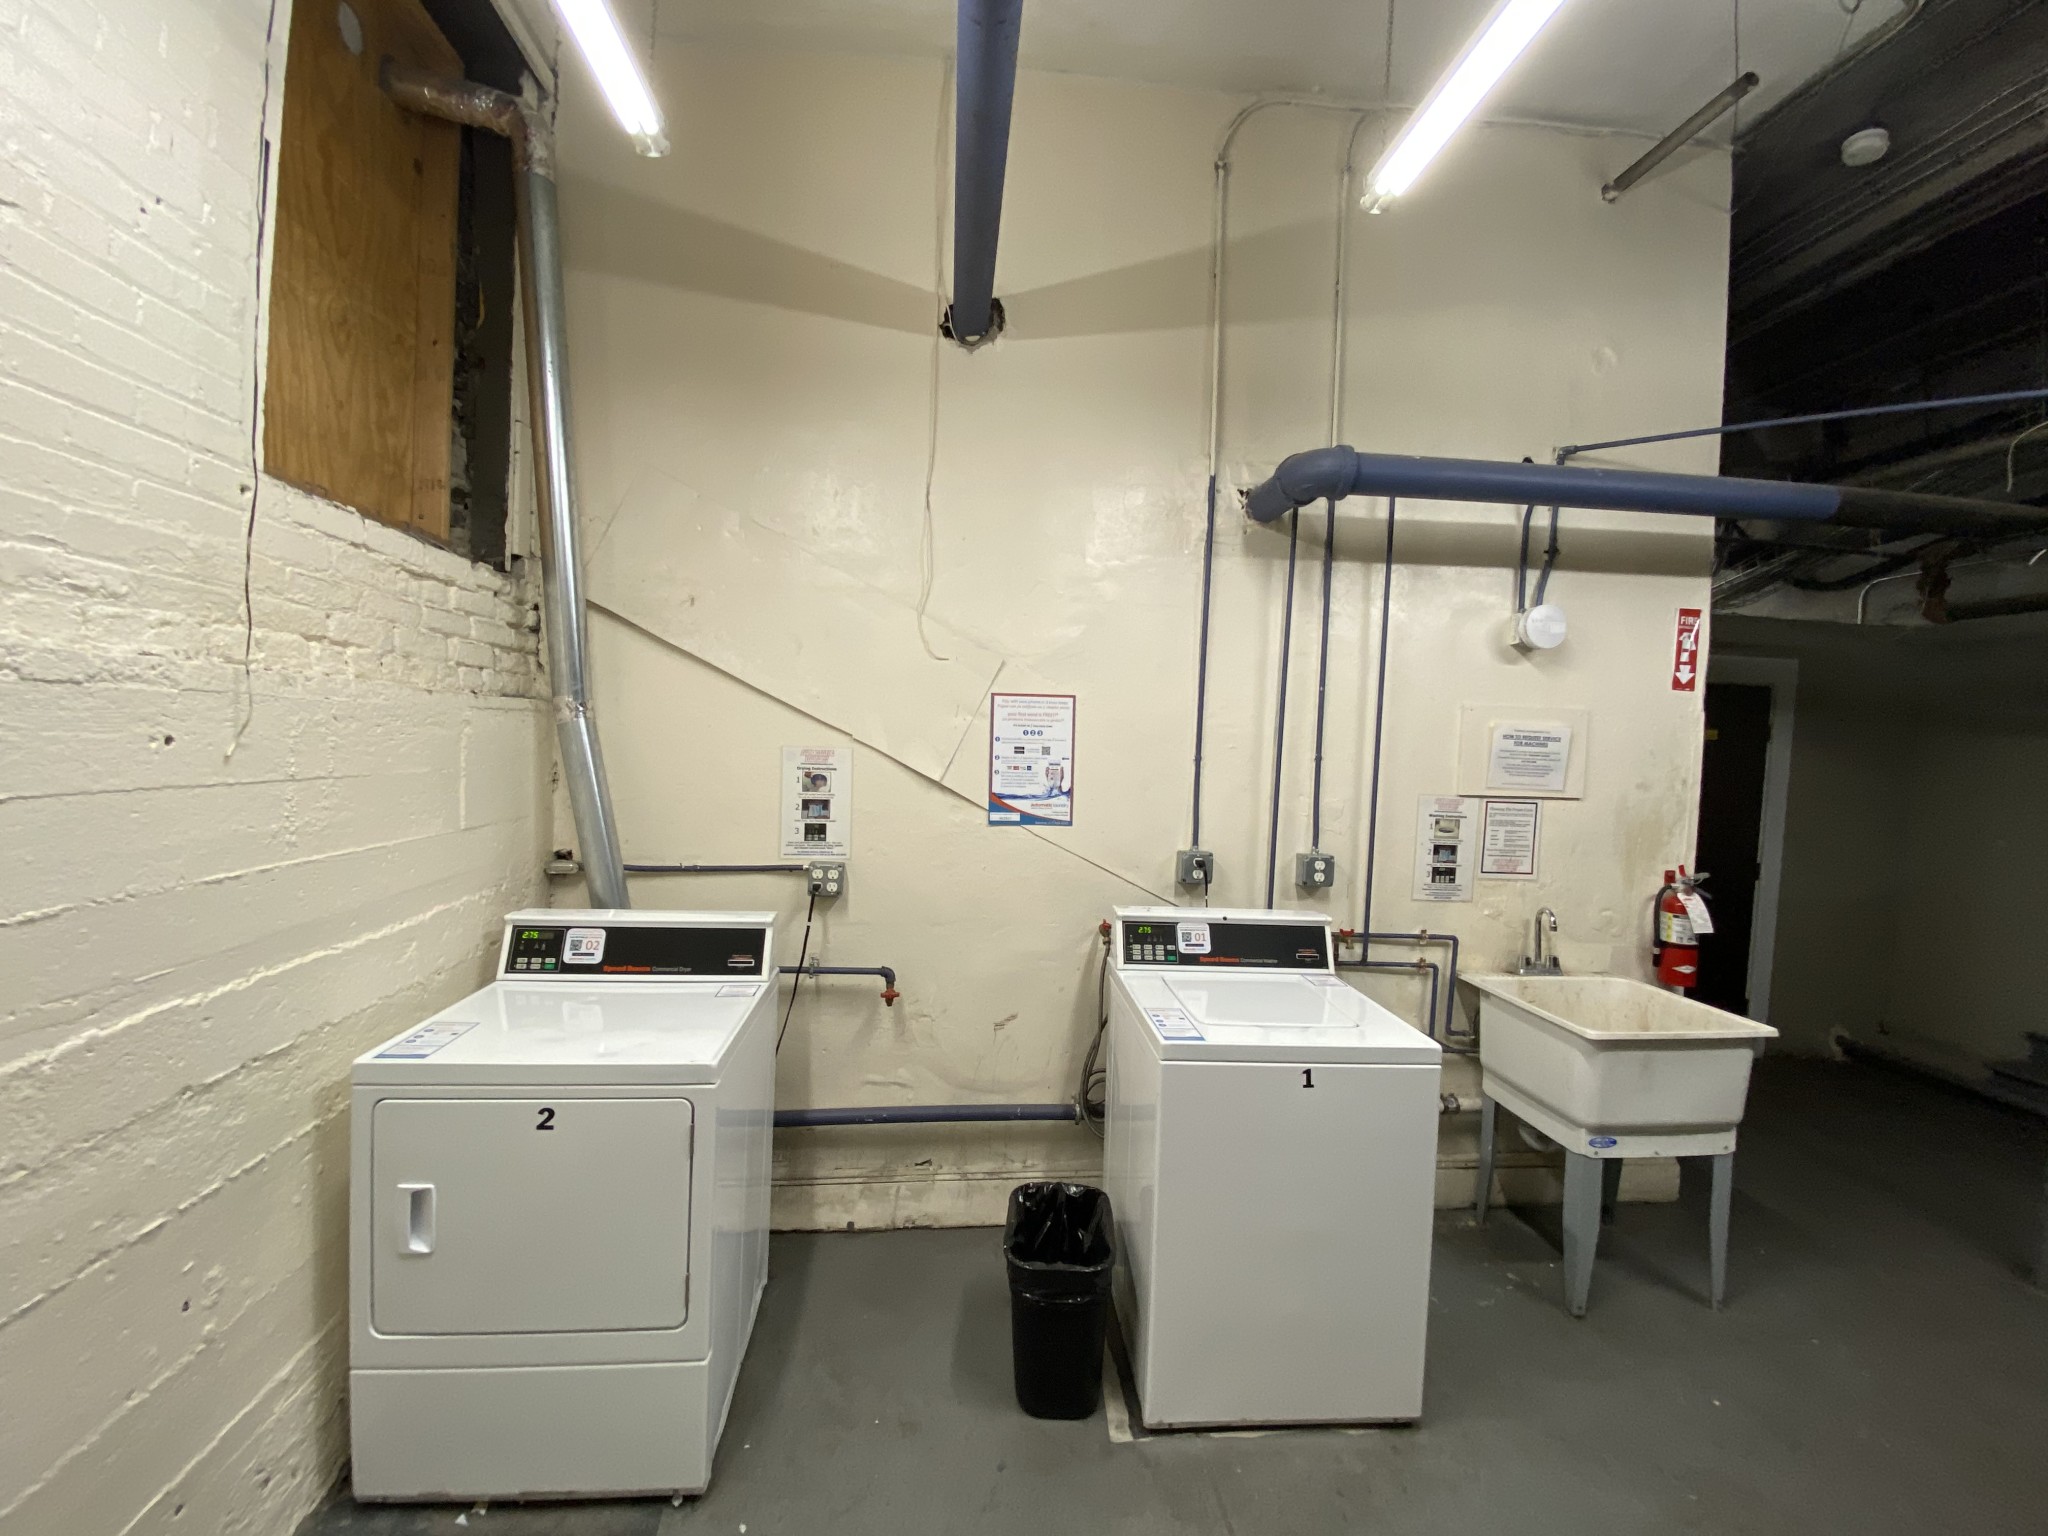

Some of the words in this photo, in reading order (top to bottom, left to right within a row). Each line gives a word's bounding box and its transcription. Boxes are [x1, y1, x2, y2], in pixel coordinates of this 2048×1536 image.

[1194, 932, 1206, 942] 01
[585, 940, 600, 950] 02
[1302, 1069, 1315, 1088] 1
[536, 1107, 555, 1130] 2
